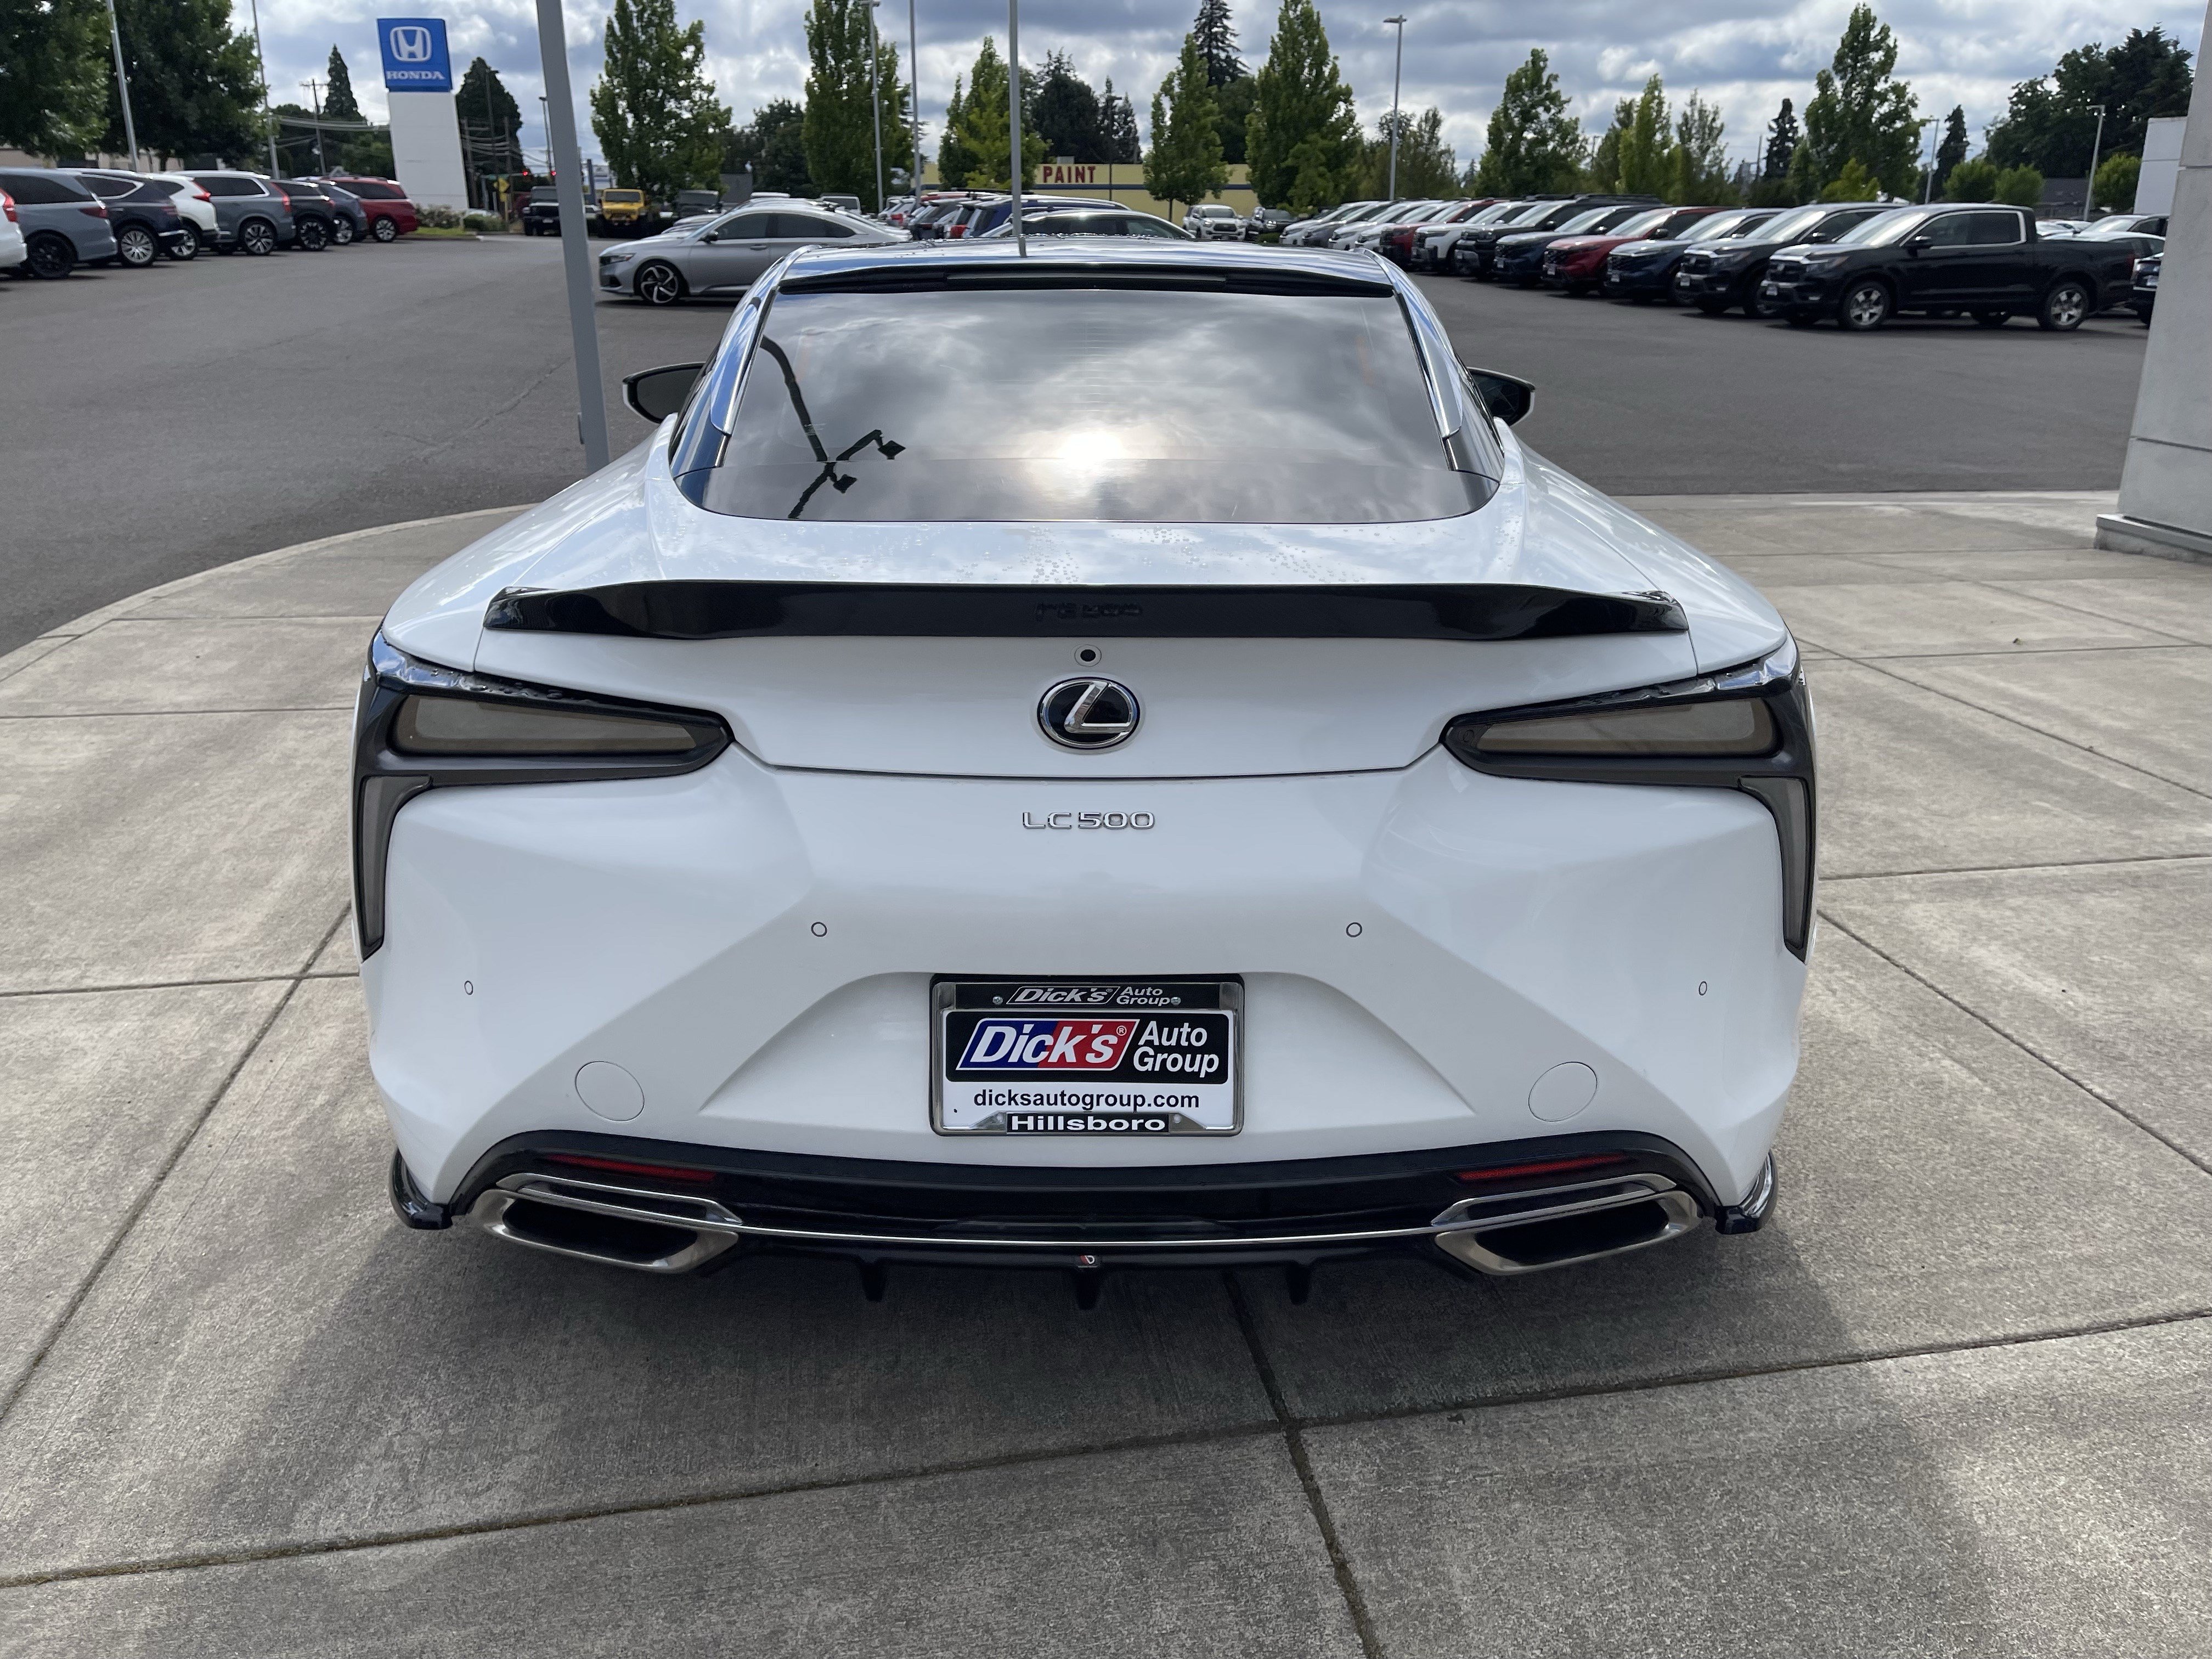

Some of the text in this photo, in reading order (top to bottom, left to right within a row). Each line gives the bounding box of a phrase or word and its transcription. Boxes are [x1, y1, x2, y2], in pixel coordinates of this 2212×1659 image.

[387, 71, 445, 80] HONDA
[1043, 165, 1096, 183] PAINT
[1120, 986, 1163, 996] Auto
[1116, 996, 1171, 1006] Group
[1138, 1021, 1208, 1047] Auto
[1132, 1046, 1220, 1077] Group
[974, 1090, 1199, 1113] dicksautogroup.com
[1011, 1115, 1166, 1131] Hillsboro
